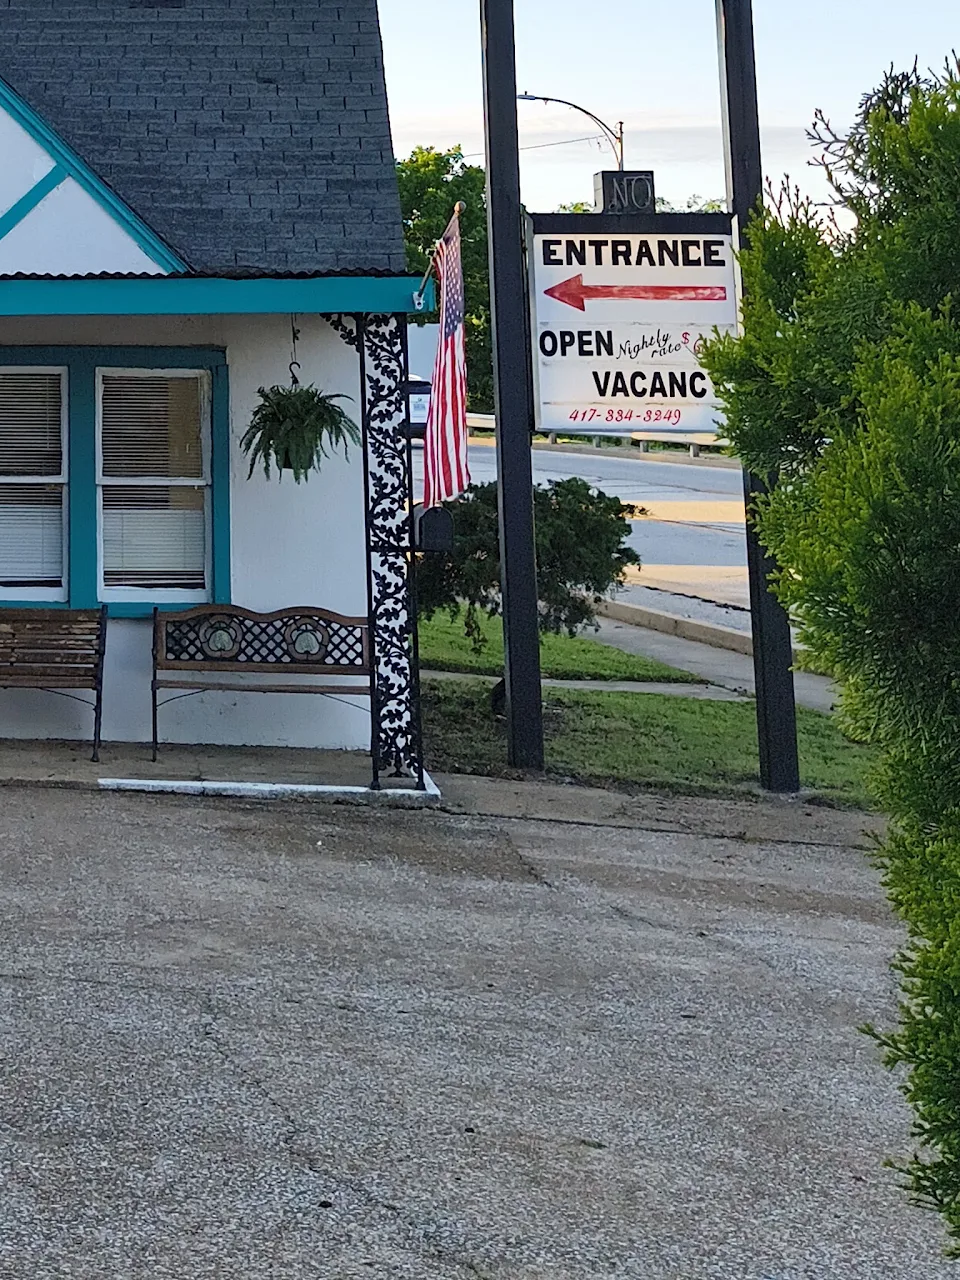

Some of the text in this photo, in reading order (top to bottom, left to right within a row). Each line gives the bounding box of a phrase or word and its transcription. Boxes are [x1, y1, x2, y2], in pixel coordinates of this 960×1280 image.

[609, 175, 651, 209] NO
[542, 239, 726, 267] ENTRANCE
[539, 330, 614, 357] OPEN
[616, 328, 671, 360] Nightly
[650, 343, 682, 358] rate
[592, 371, 708, 398] VACANC
